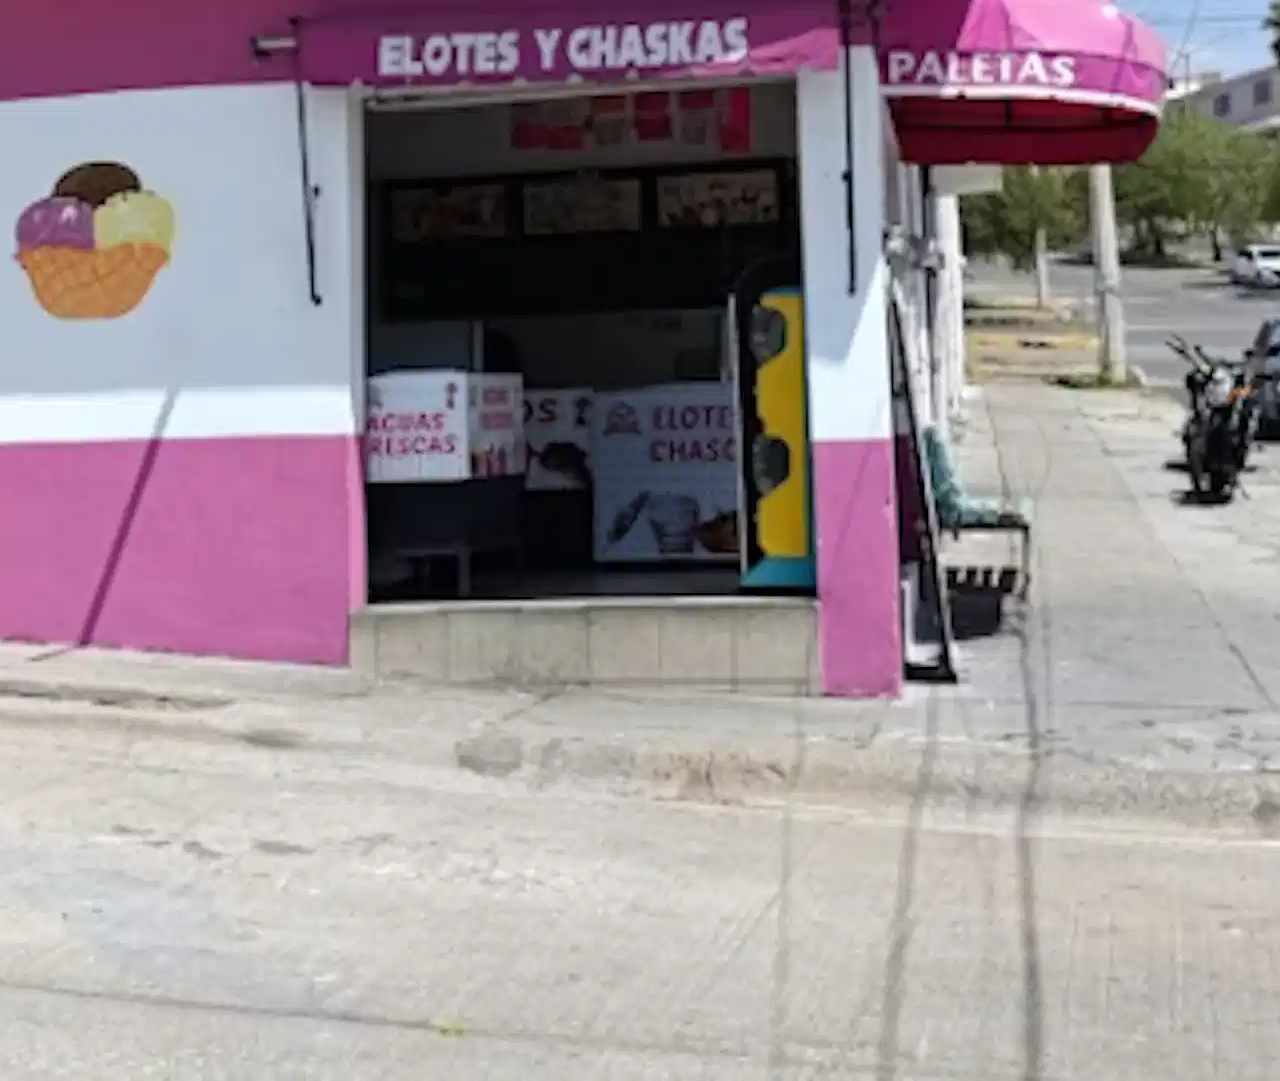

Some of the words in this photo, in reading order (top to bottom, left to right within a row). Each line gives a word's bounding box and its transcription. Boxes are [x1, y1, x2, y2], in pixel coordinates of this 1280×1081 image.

[376, 29, 519, 77] ELOTES
[532, 26, 564, 70] Y
[566, 16, 750, 70] CHASKAS
[886, 50, 1077, 87] PALETAS
